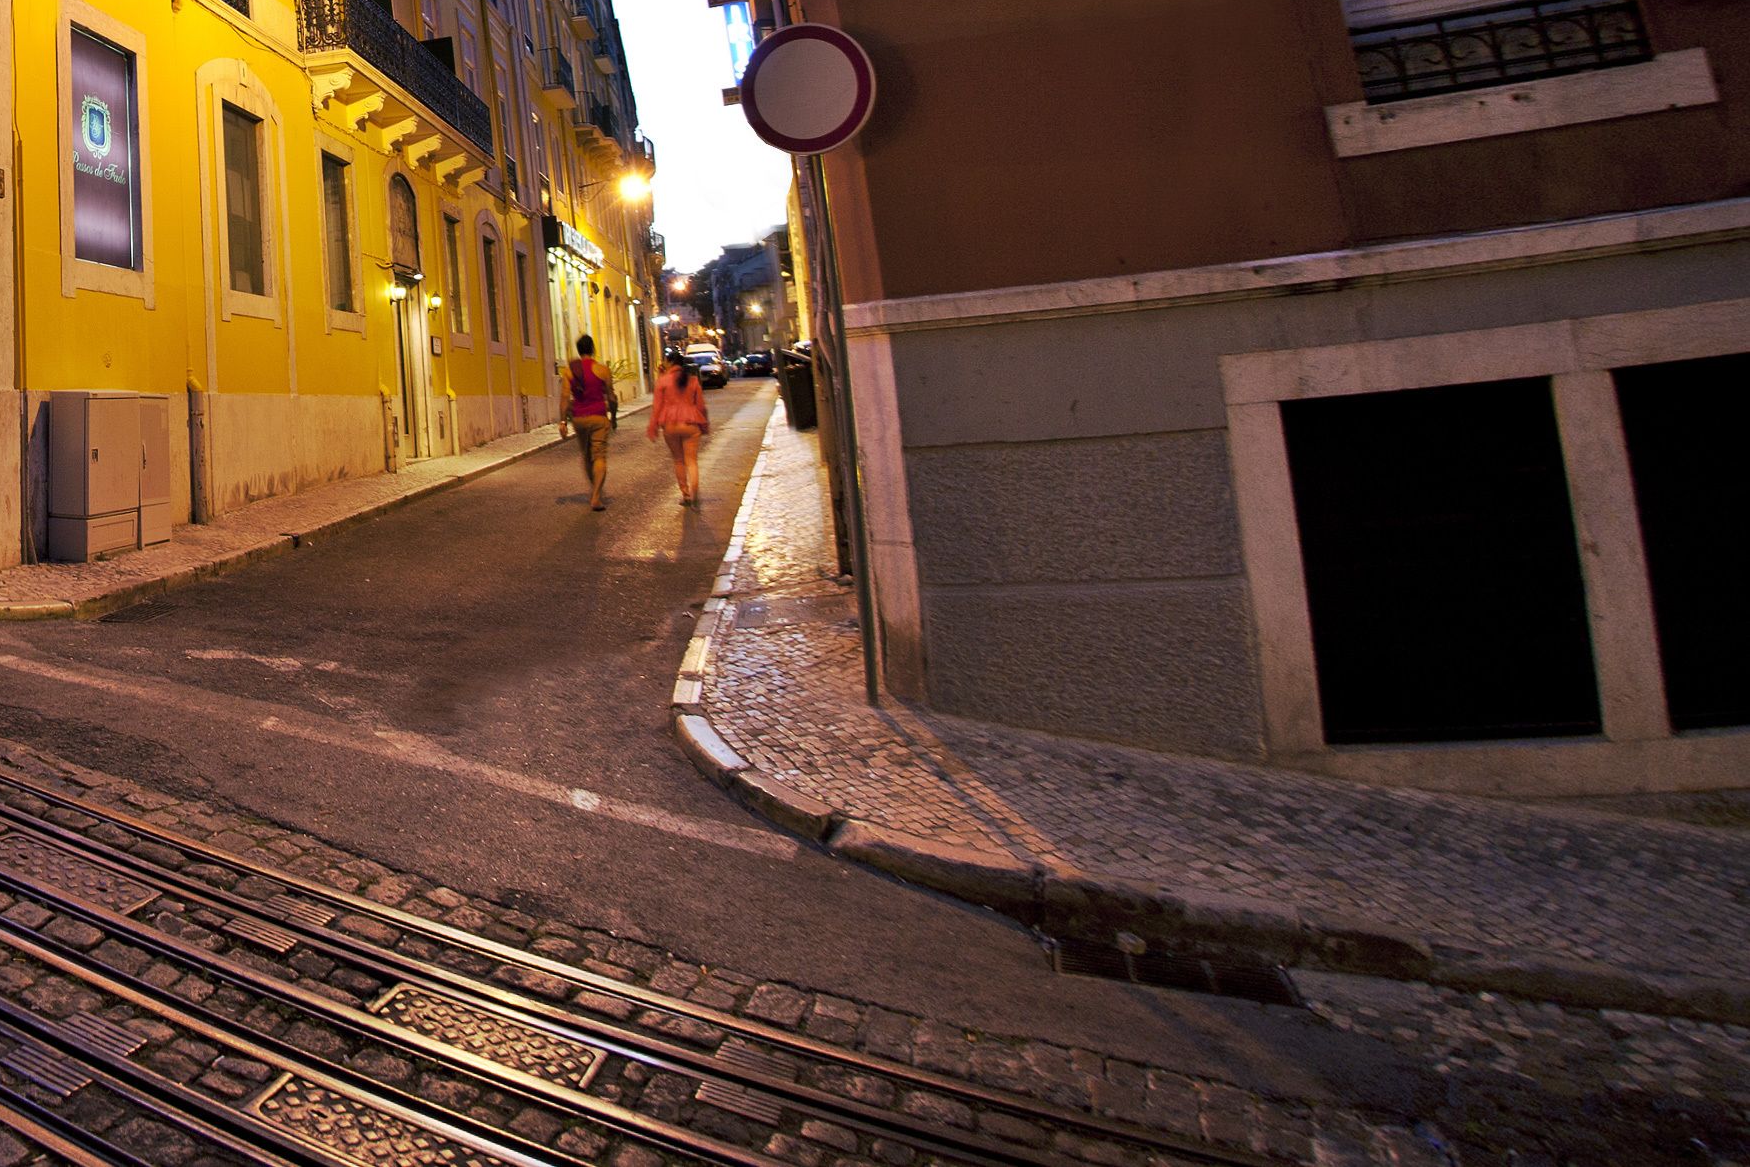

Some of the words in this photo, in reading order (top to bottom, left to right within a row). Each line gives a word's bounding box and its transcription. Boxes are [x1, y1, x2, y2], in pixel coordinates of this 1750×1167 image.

[73, 151, 93, 175] Passos
[94, 162, 103, 177] de
[104, 163, 126, 185] Fado
